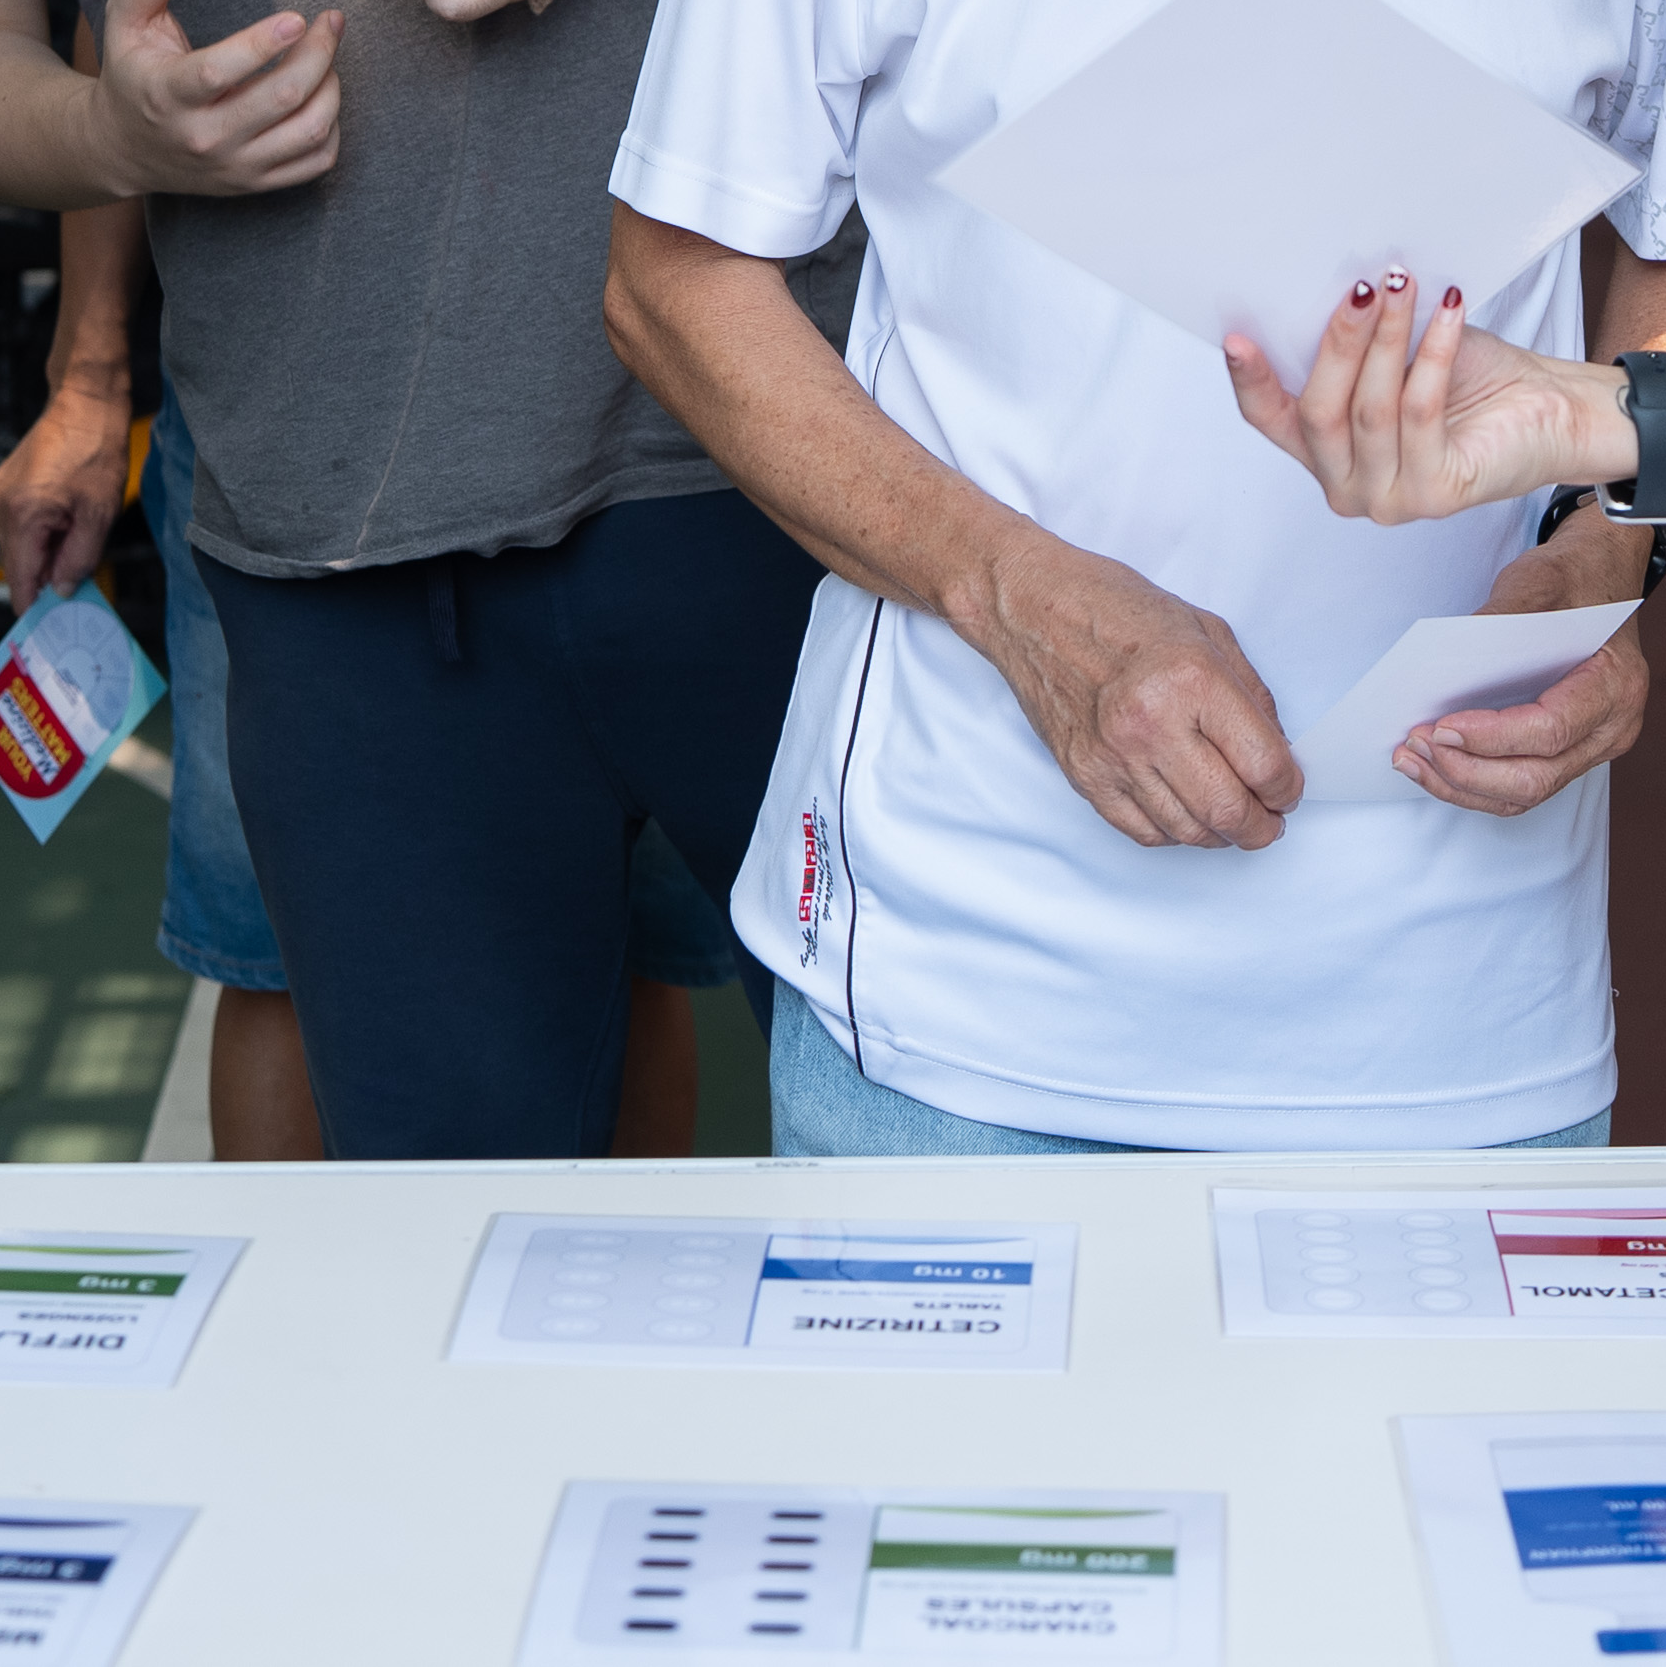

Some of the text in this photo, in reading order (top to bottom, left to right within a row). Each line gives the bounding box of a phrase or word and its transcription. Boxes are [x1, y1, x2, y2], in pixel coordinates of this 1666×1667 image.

[9, 676, 72, 767] MATTERS
[2, 694, 59, 774] Medicine
[913, 1264, 1007, 1279] 10 mg
[75, 1274, 158, 1291] 3 mg
[912, 1301, 1004, 1311] TABLETS
[791, 1316, 1001, 1334] CETIRIZINE
[1018, 1547, 1077, 1565] mg
[924, 1598, 1113, 1614] CAPSULES
[918, 1616, 1117, 1636] CHARCOAL
